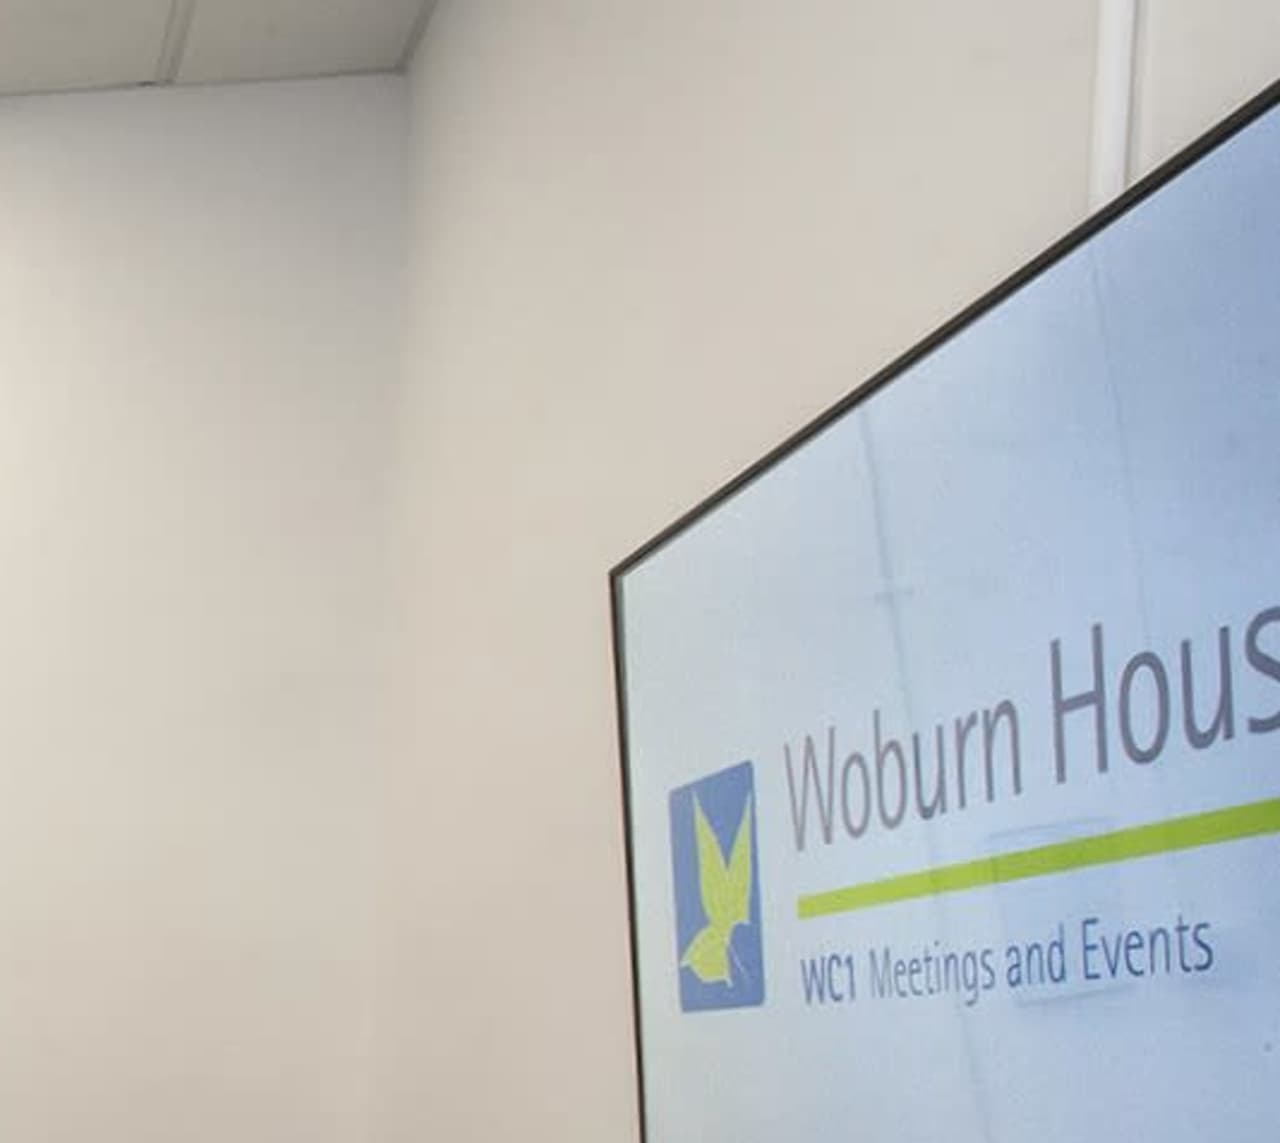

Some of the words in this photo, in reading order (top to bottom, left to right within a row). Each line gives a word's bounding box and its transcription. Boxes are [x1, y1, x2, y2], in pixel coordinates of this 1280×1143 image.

[783, 699, 1023, 851] Woburn
[800, 953, 856, 1006] WC1
[869, 940, 996, 1007] Meetings
[1006, 922, 1067, 988] and
[1082, 914, 1214, 980] Events
